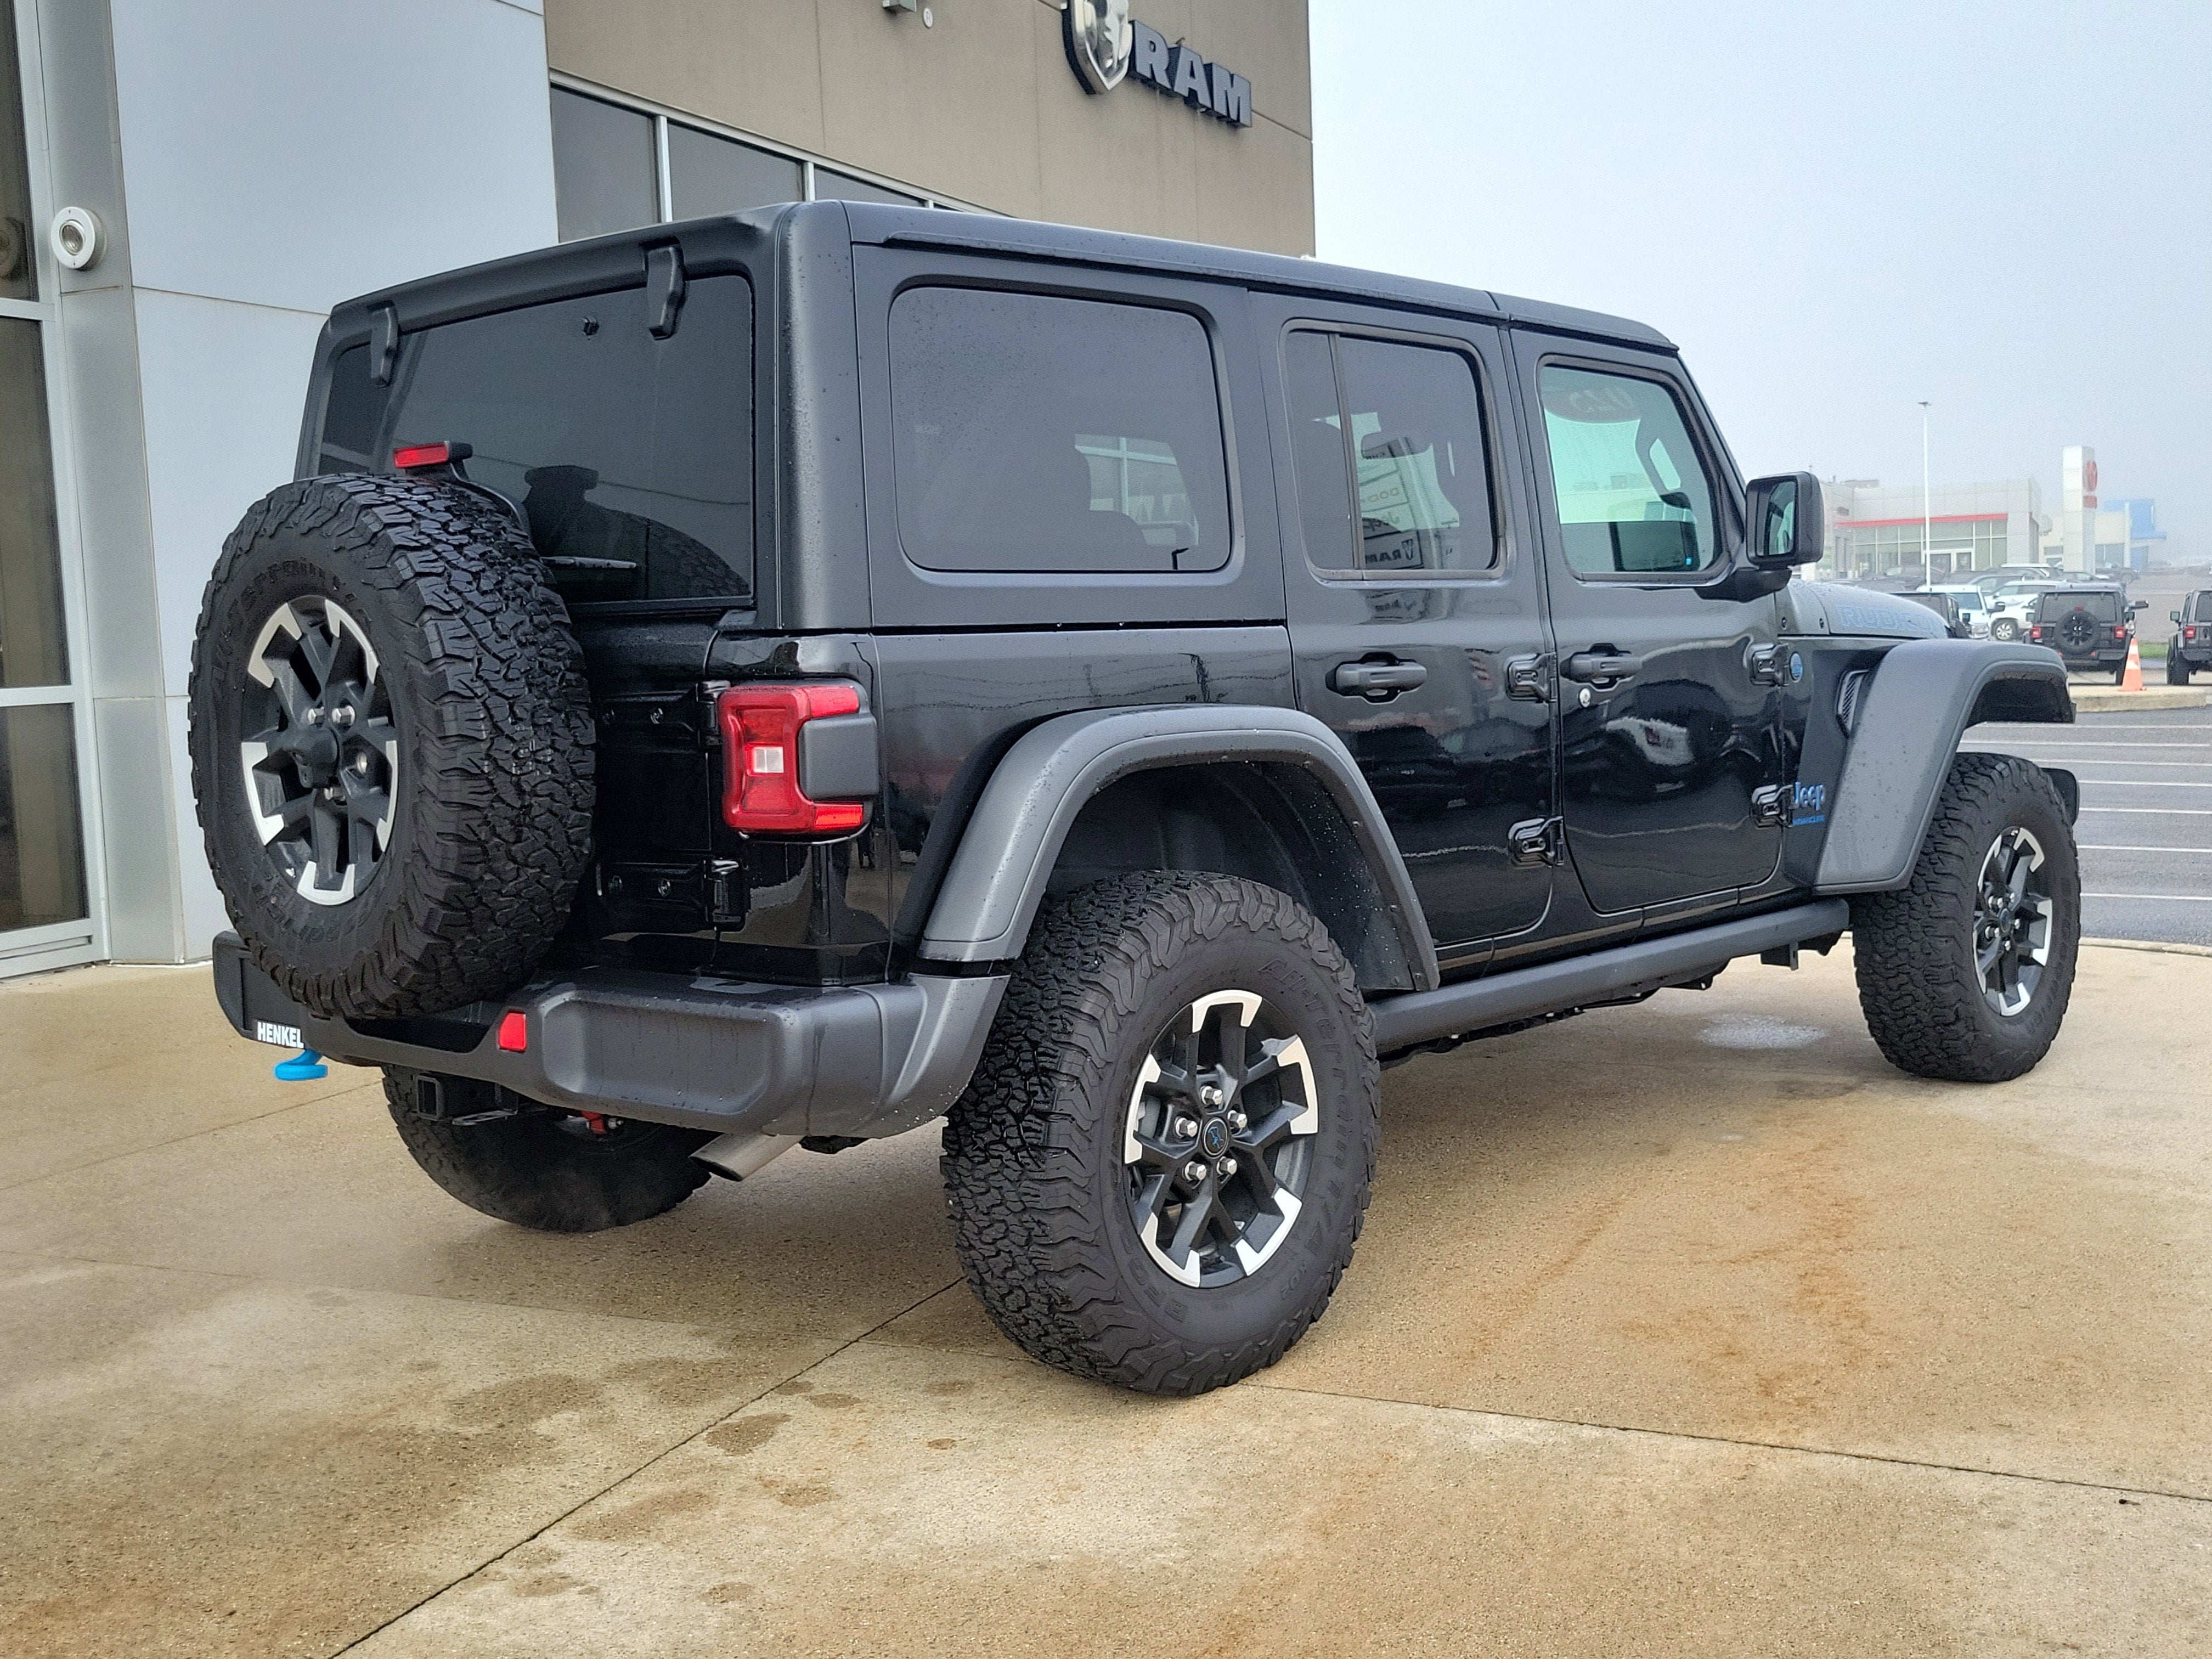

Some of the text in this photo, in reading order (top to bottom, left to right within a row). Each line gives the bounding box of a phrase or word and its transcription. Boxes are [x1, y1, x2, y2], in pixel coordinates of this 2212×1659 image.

[1131, 20, 1251, 127] RAM
[1790, 781, 1826, 811] Jeep
[257, 1021, 304, 1049] HENKEL
[1258, 958, 1352, 1169] All-Terrain
